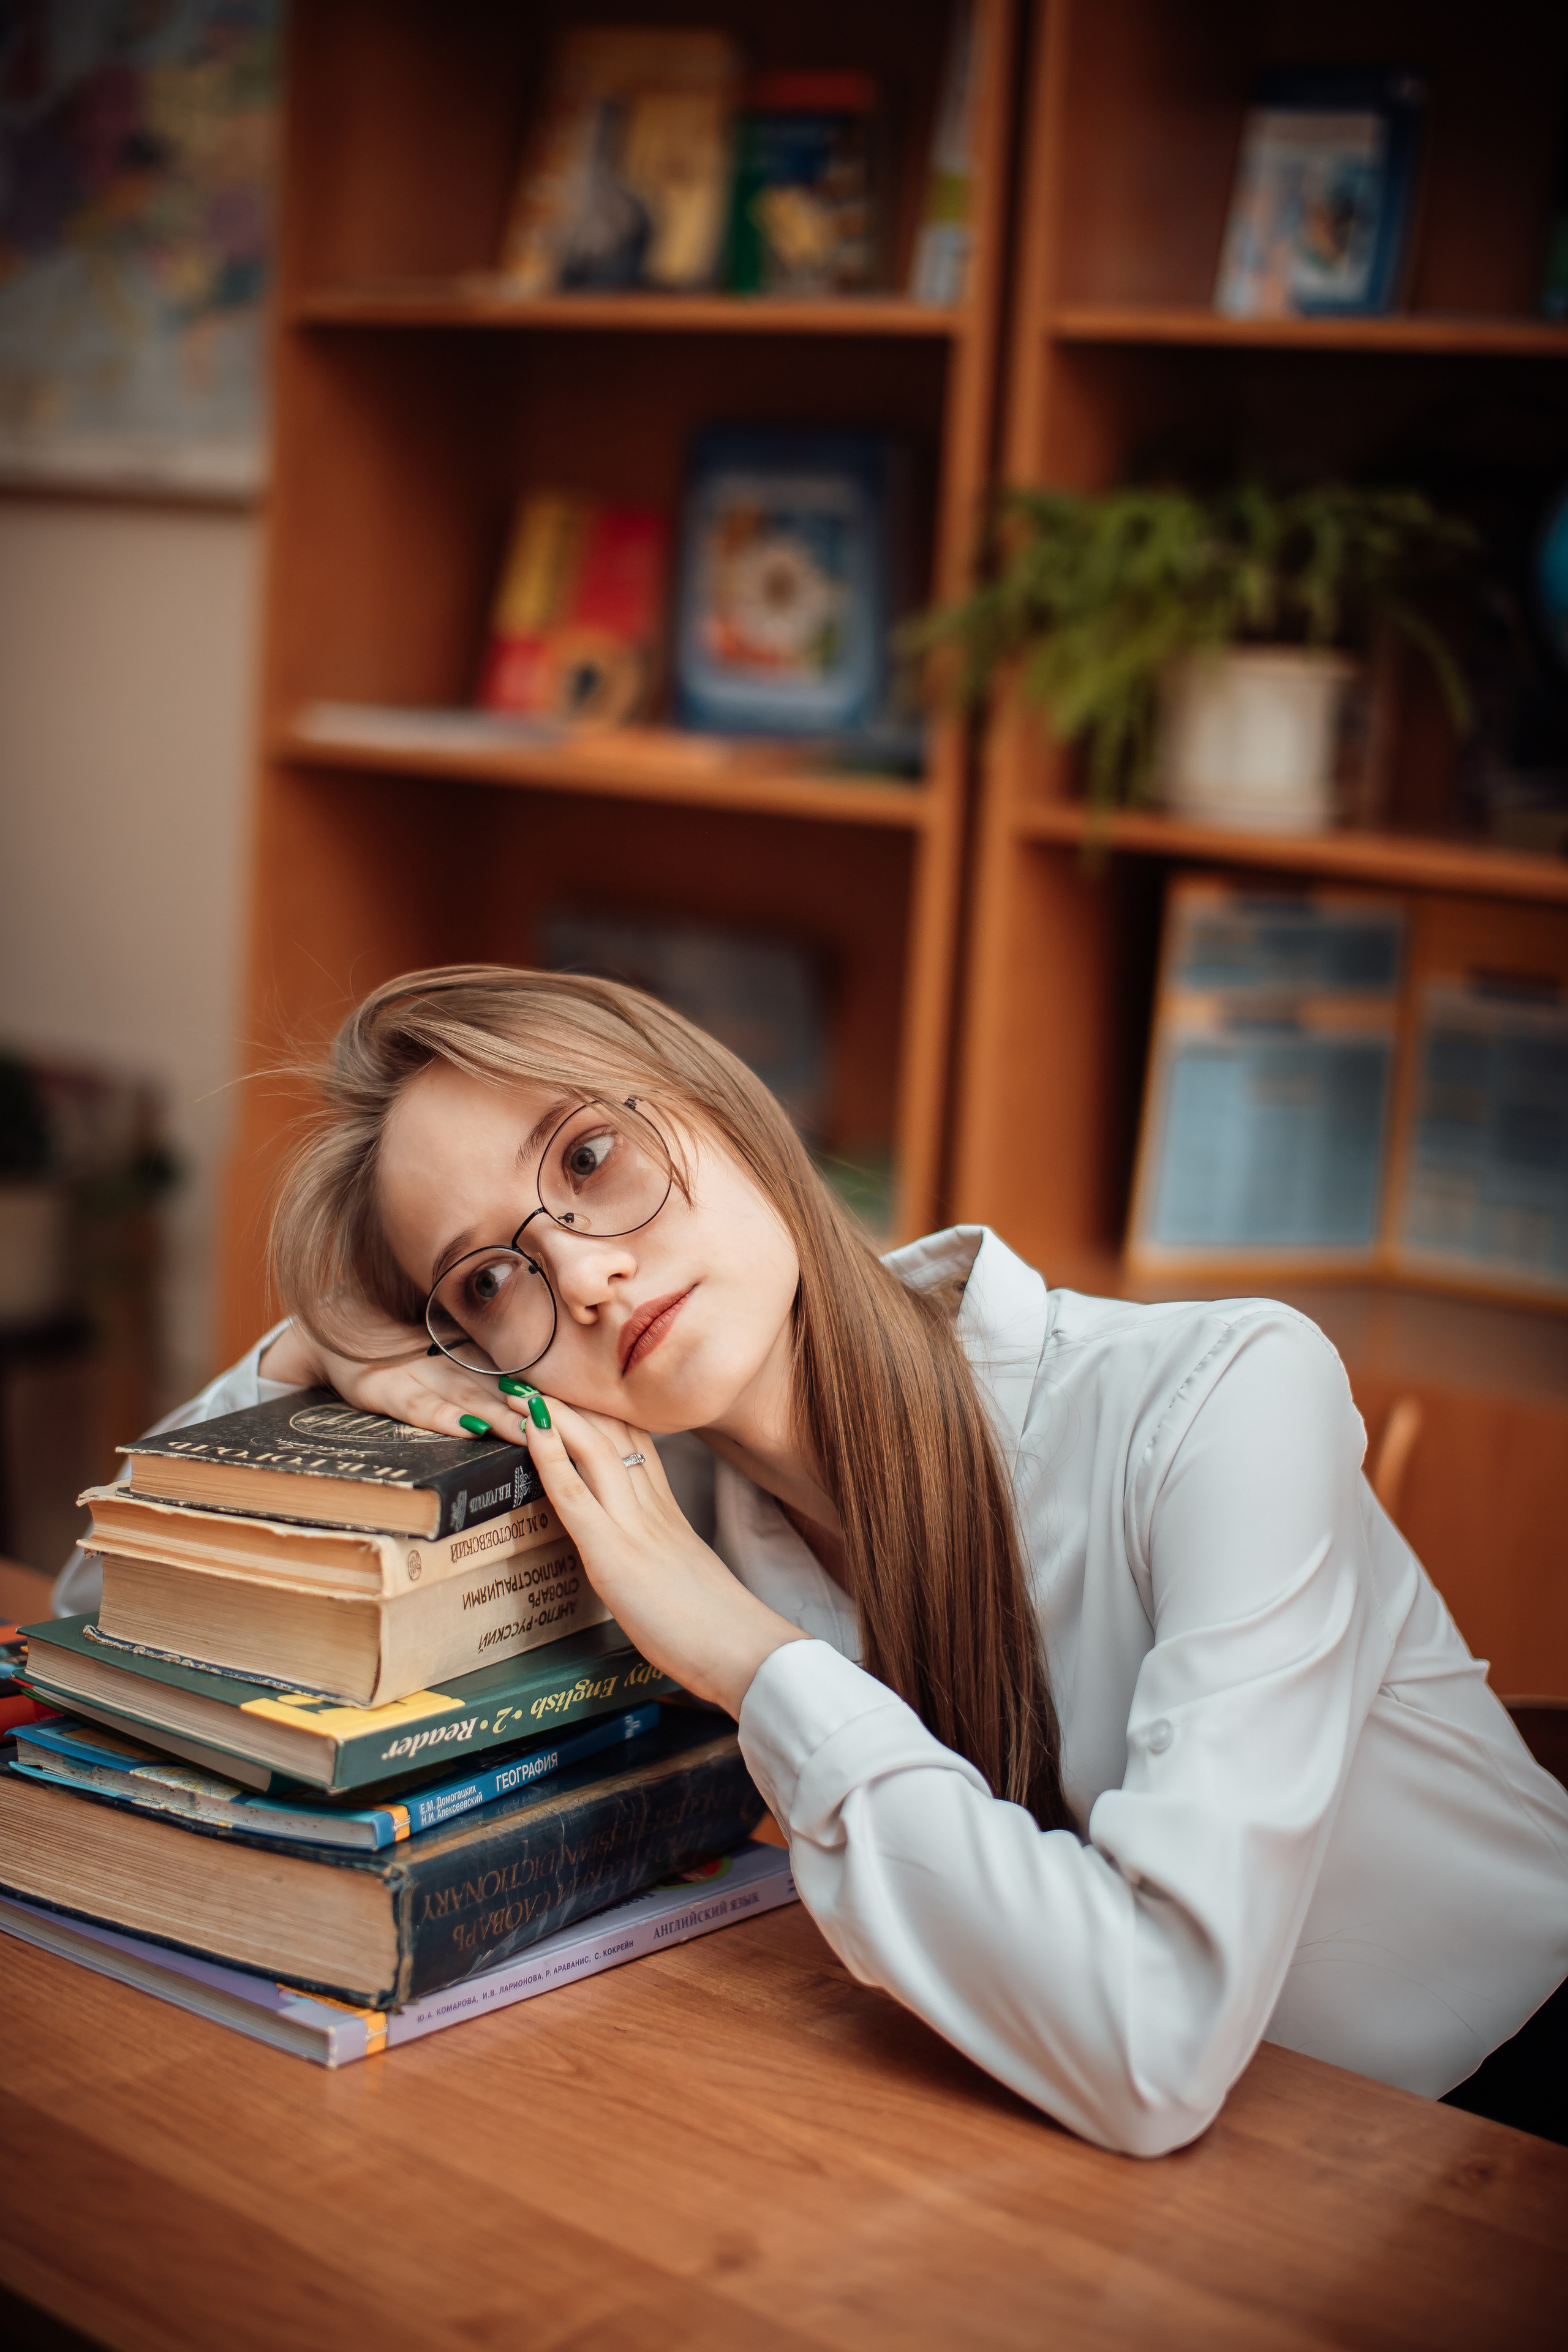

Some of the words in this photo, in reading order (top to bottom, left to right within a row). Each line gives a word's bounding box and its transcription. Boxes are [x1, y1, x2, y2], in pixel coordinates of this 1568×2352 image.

[462, 1559, 567, 1611] ИЛЛЮСТРАЦИЯМИ
[568, 1555, 577, 1571] С
[528, 1577, 580, 1609] СЛОВАРЬ
[478, 1598, 578, 1654] АНГЛО-РУССКИЙ
[530, 1675, 617, 1719] English
[380, 1716, 480, 1761] Reader
[495, 1751, 558, 1792] ГЕОГРАФИЯ
[436, 1784, 477, 1809] Домогацких
[437, 1791, 483, 1820] Алексеевский
[421, 1853, 559, 1922] DICTIONARY
[453, 1889, 552, 1952] СЛОВАРЬ
[653, 1900, 729, 1940] АНГЛИЙСКИЙ
[729, 1891, 761, 1912] ЯЗЫК
[436, 1995, 480, 2016] КОМАРОВА,
[499, 1972, 545, 1995] ЛАРИОНОВА,
[553, 1955, 592, 1975] АРАВАНИС,
[603, 1939, 635, 1958] КОКРЕЙН
